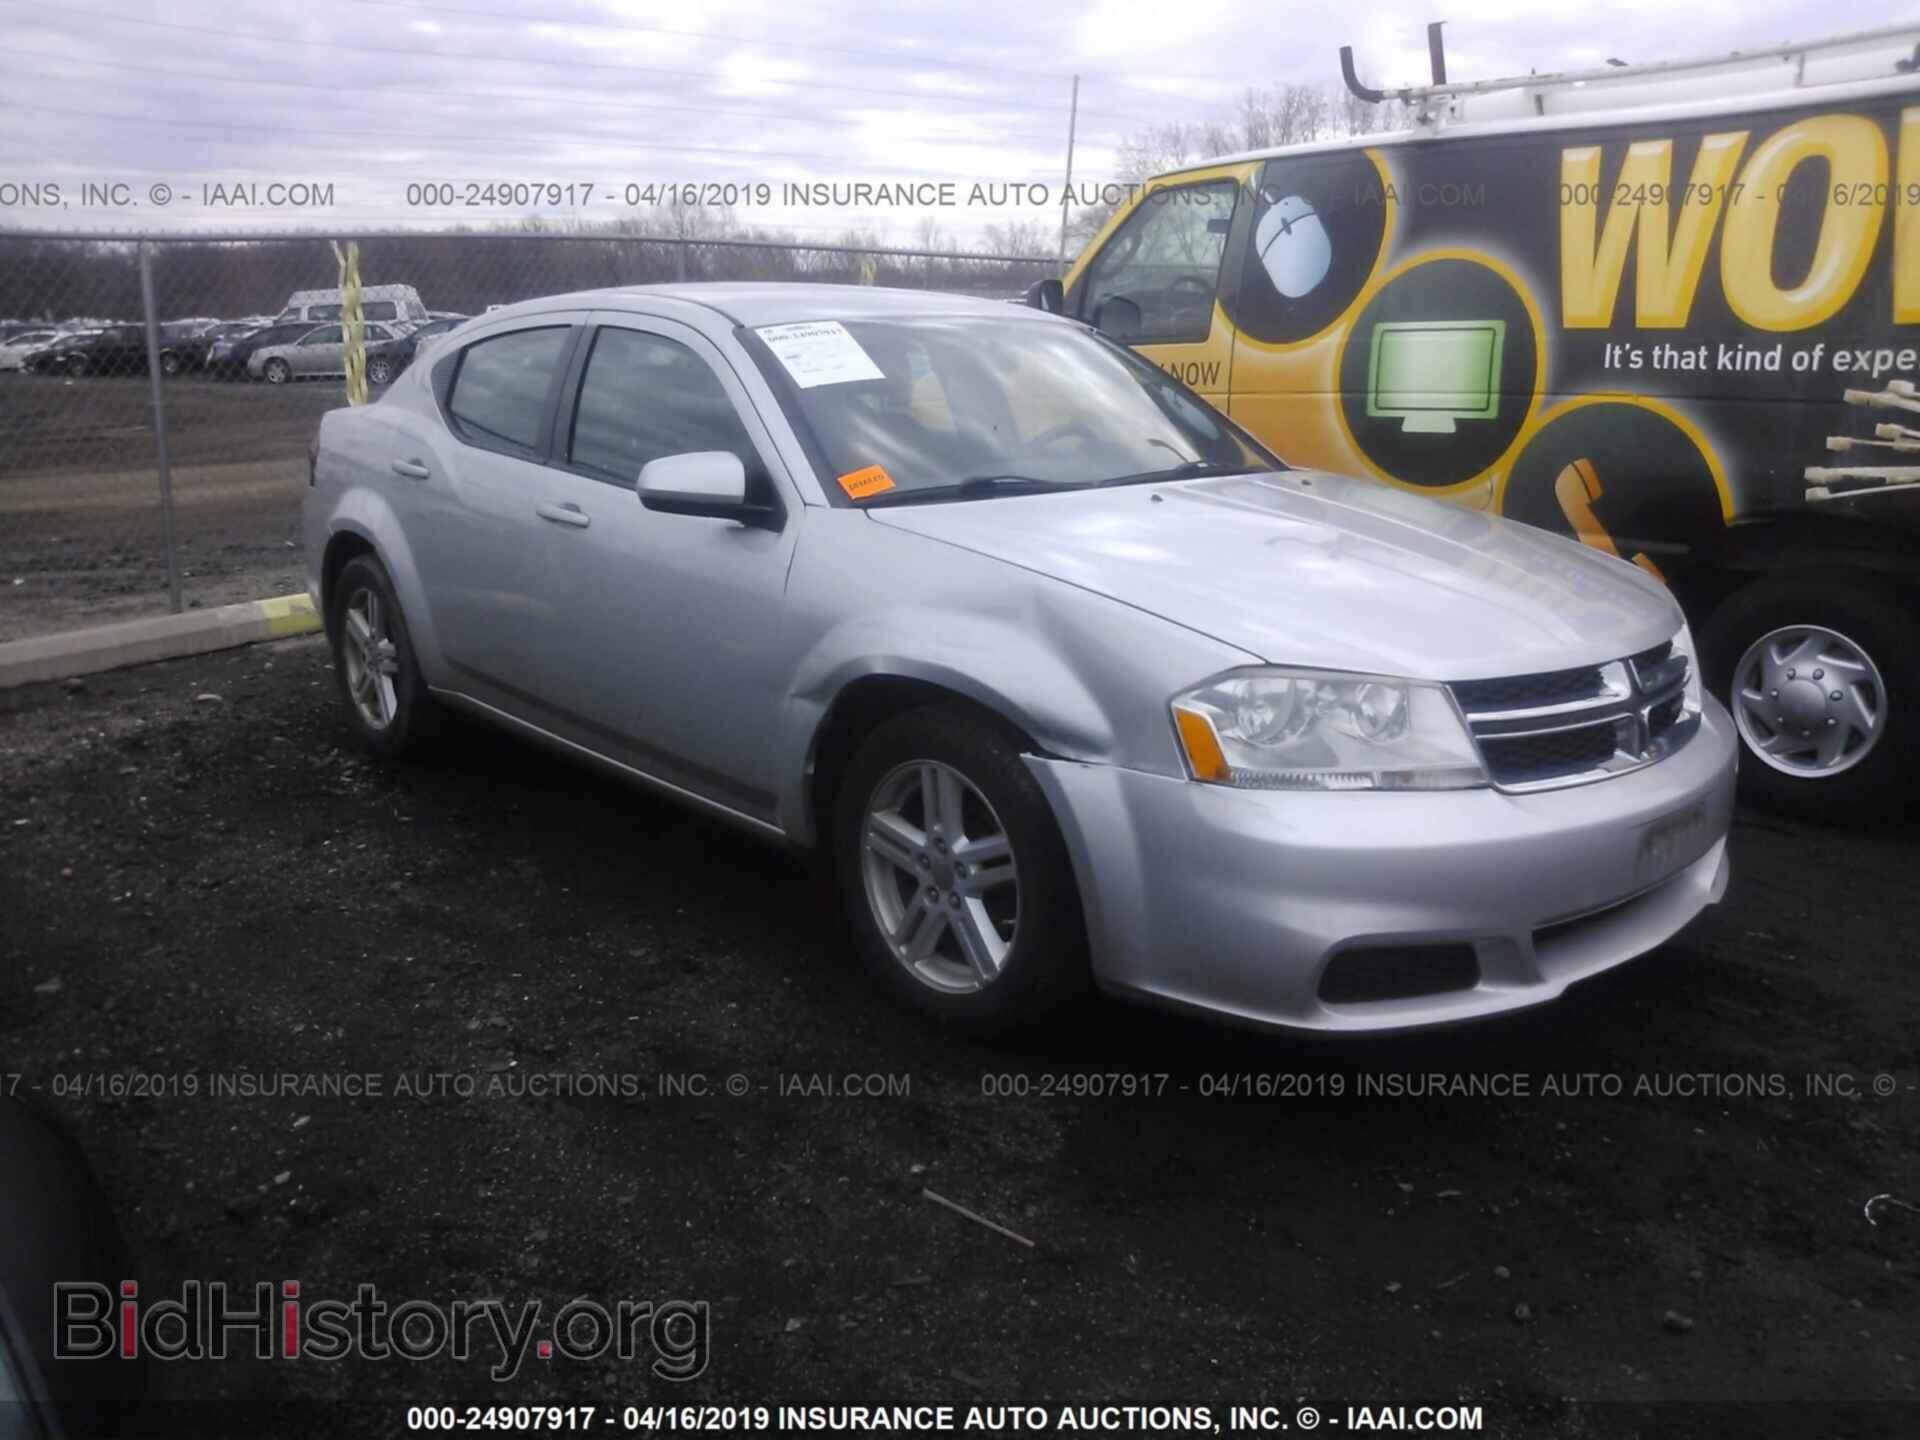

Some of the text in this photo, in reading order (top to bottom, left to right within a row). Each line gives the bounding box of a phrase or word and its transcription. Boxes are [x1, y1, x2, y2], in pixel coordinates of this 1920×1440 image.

[1559, 105, 1920, 333] WO
[1603, 343, 1643, 369] It's
[1652, 344, 1709, 370] that
[1716, 343, 1782, 371] kind
[1791, 343, 1825, 371] of
